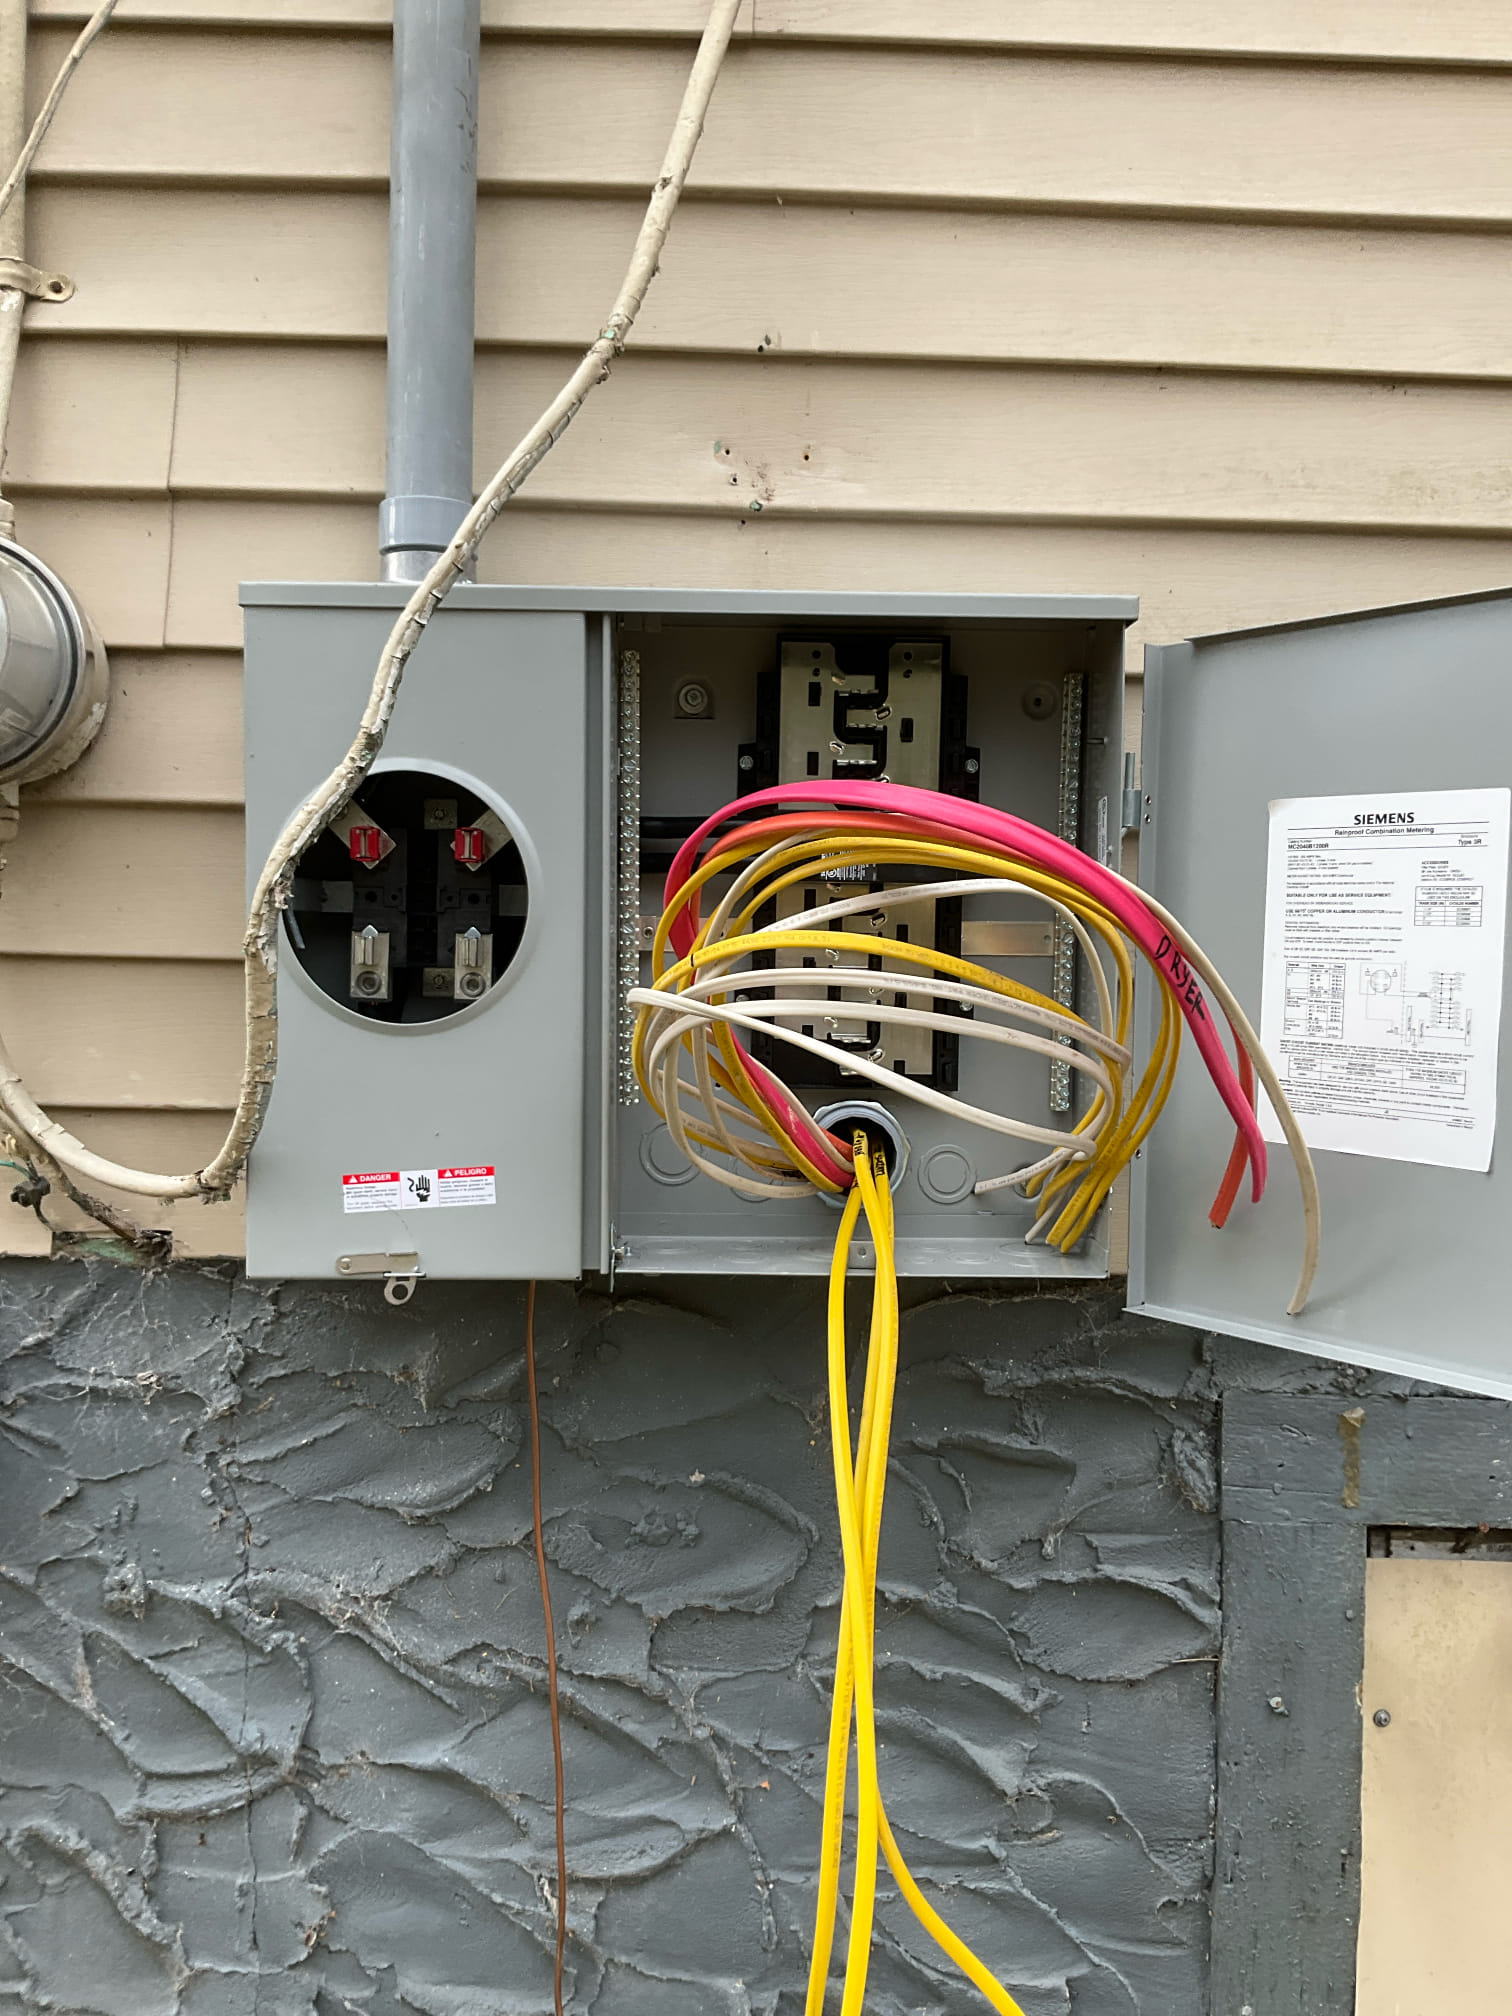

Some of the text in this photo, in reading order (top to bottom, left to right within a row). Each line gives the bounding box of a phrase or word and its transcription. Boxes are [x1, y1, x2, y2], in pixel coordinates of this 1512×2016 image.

[1353, 812, 1415, 825] SIEMENS
[1334, 829, 1364, 838] Rainproof
[1406, 827, 1435, 835] Metering
[1154, 934, 1206, 1021] DRYER
[359, 1173, 392, 1182] DANGER
[454, 1168, 487, 1176] PELIGRO
